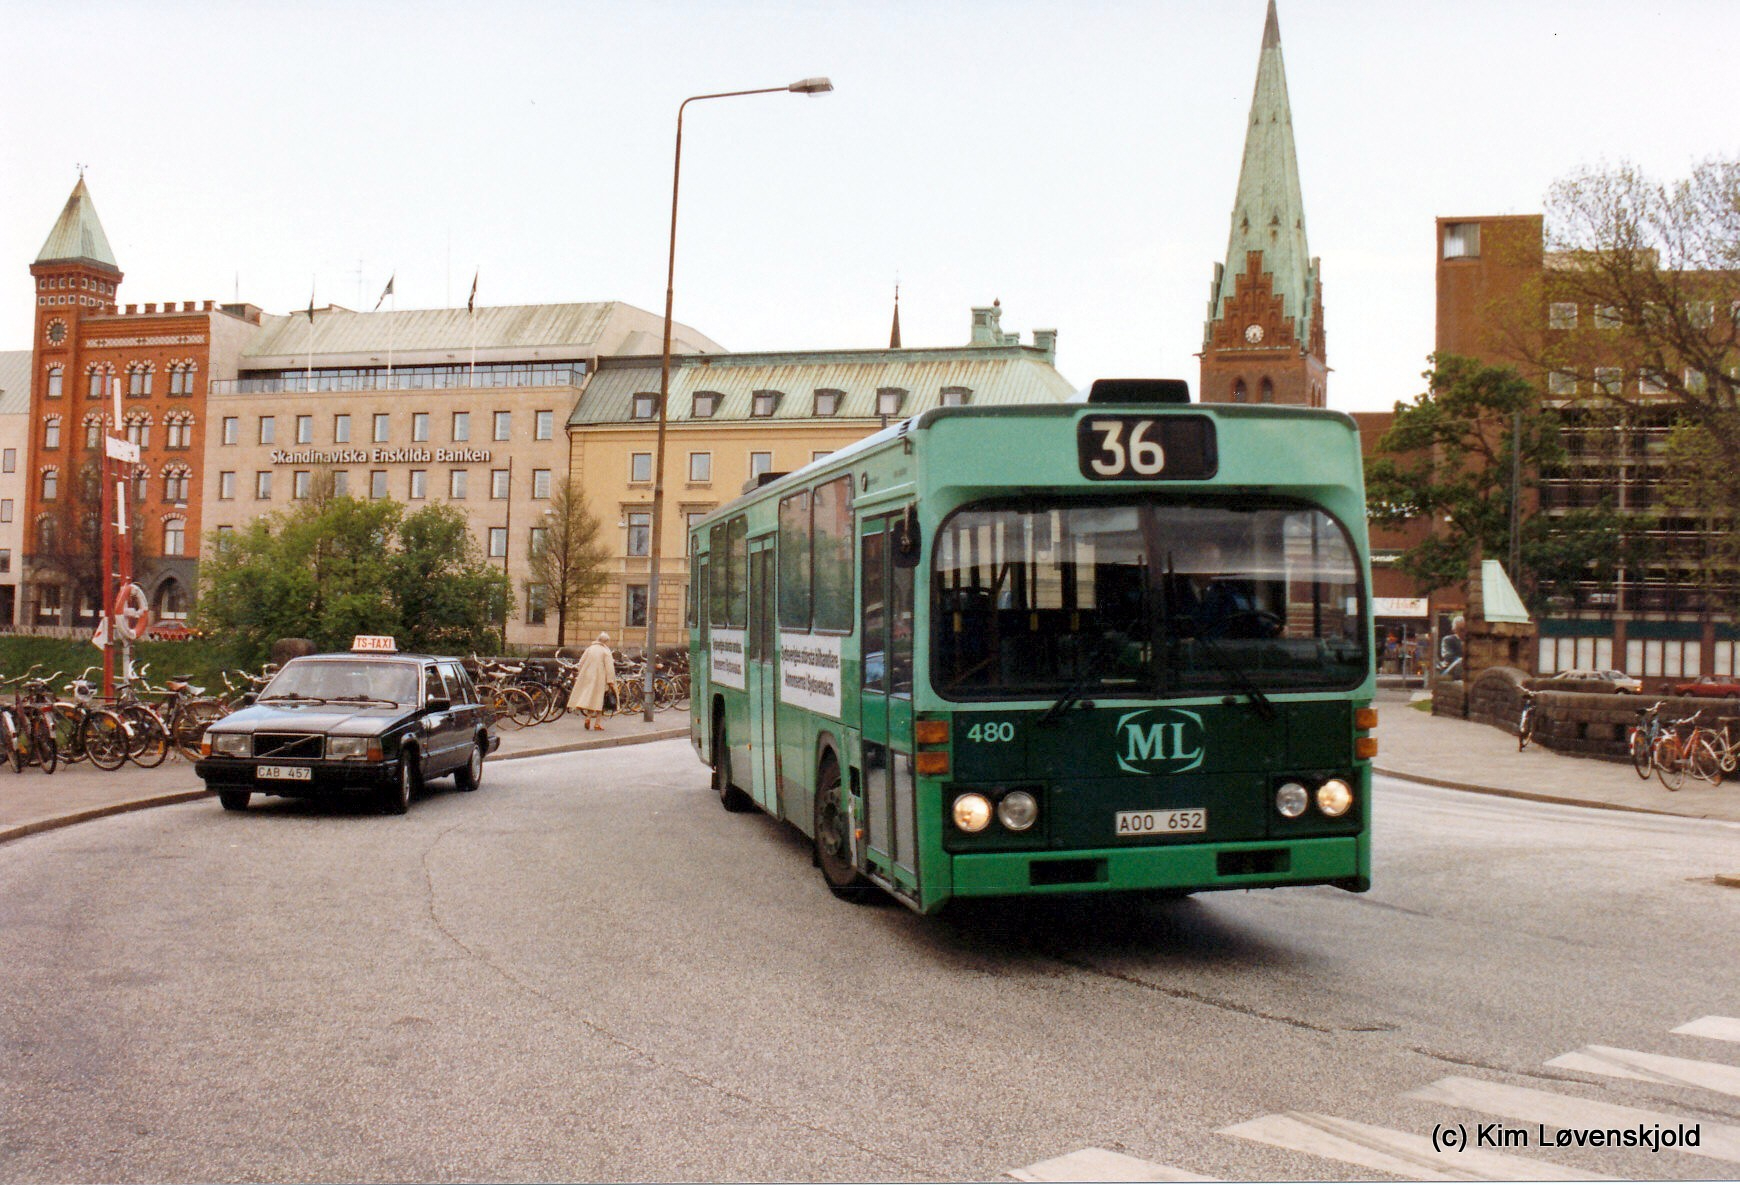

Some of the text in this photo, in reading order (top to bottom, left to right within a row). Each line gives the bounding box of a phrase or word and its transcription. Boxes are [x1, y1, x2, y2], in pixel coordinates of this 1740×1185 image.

[270, 448, 491, 464] Skandinaviska Enskilda Banken
[1091, 420, 1165, 475] 36
[356, 637, 393, 649] TS-TAXI
[967, 721, 1015, 743] 480
[1125, 721, 1201, 761] ML
[258, 767, 311, 778] CAB 457
[1168, 812, 1202, 829] 652
